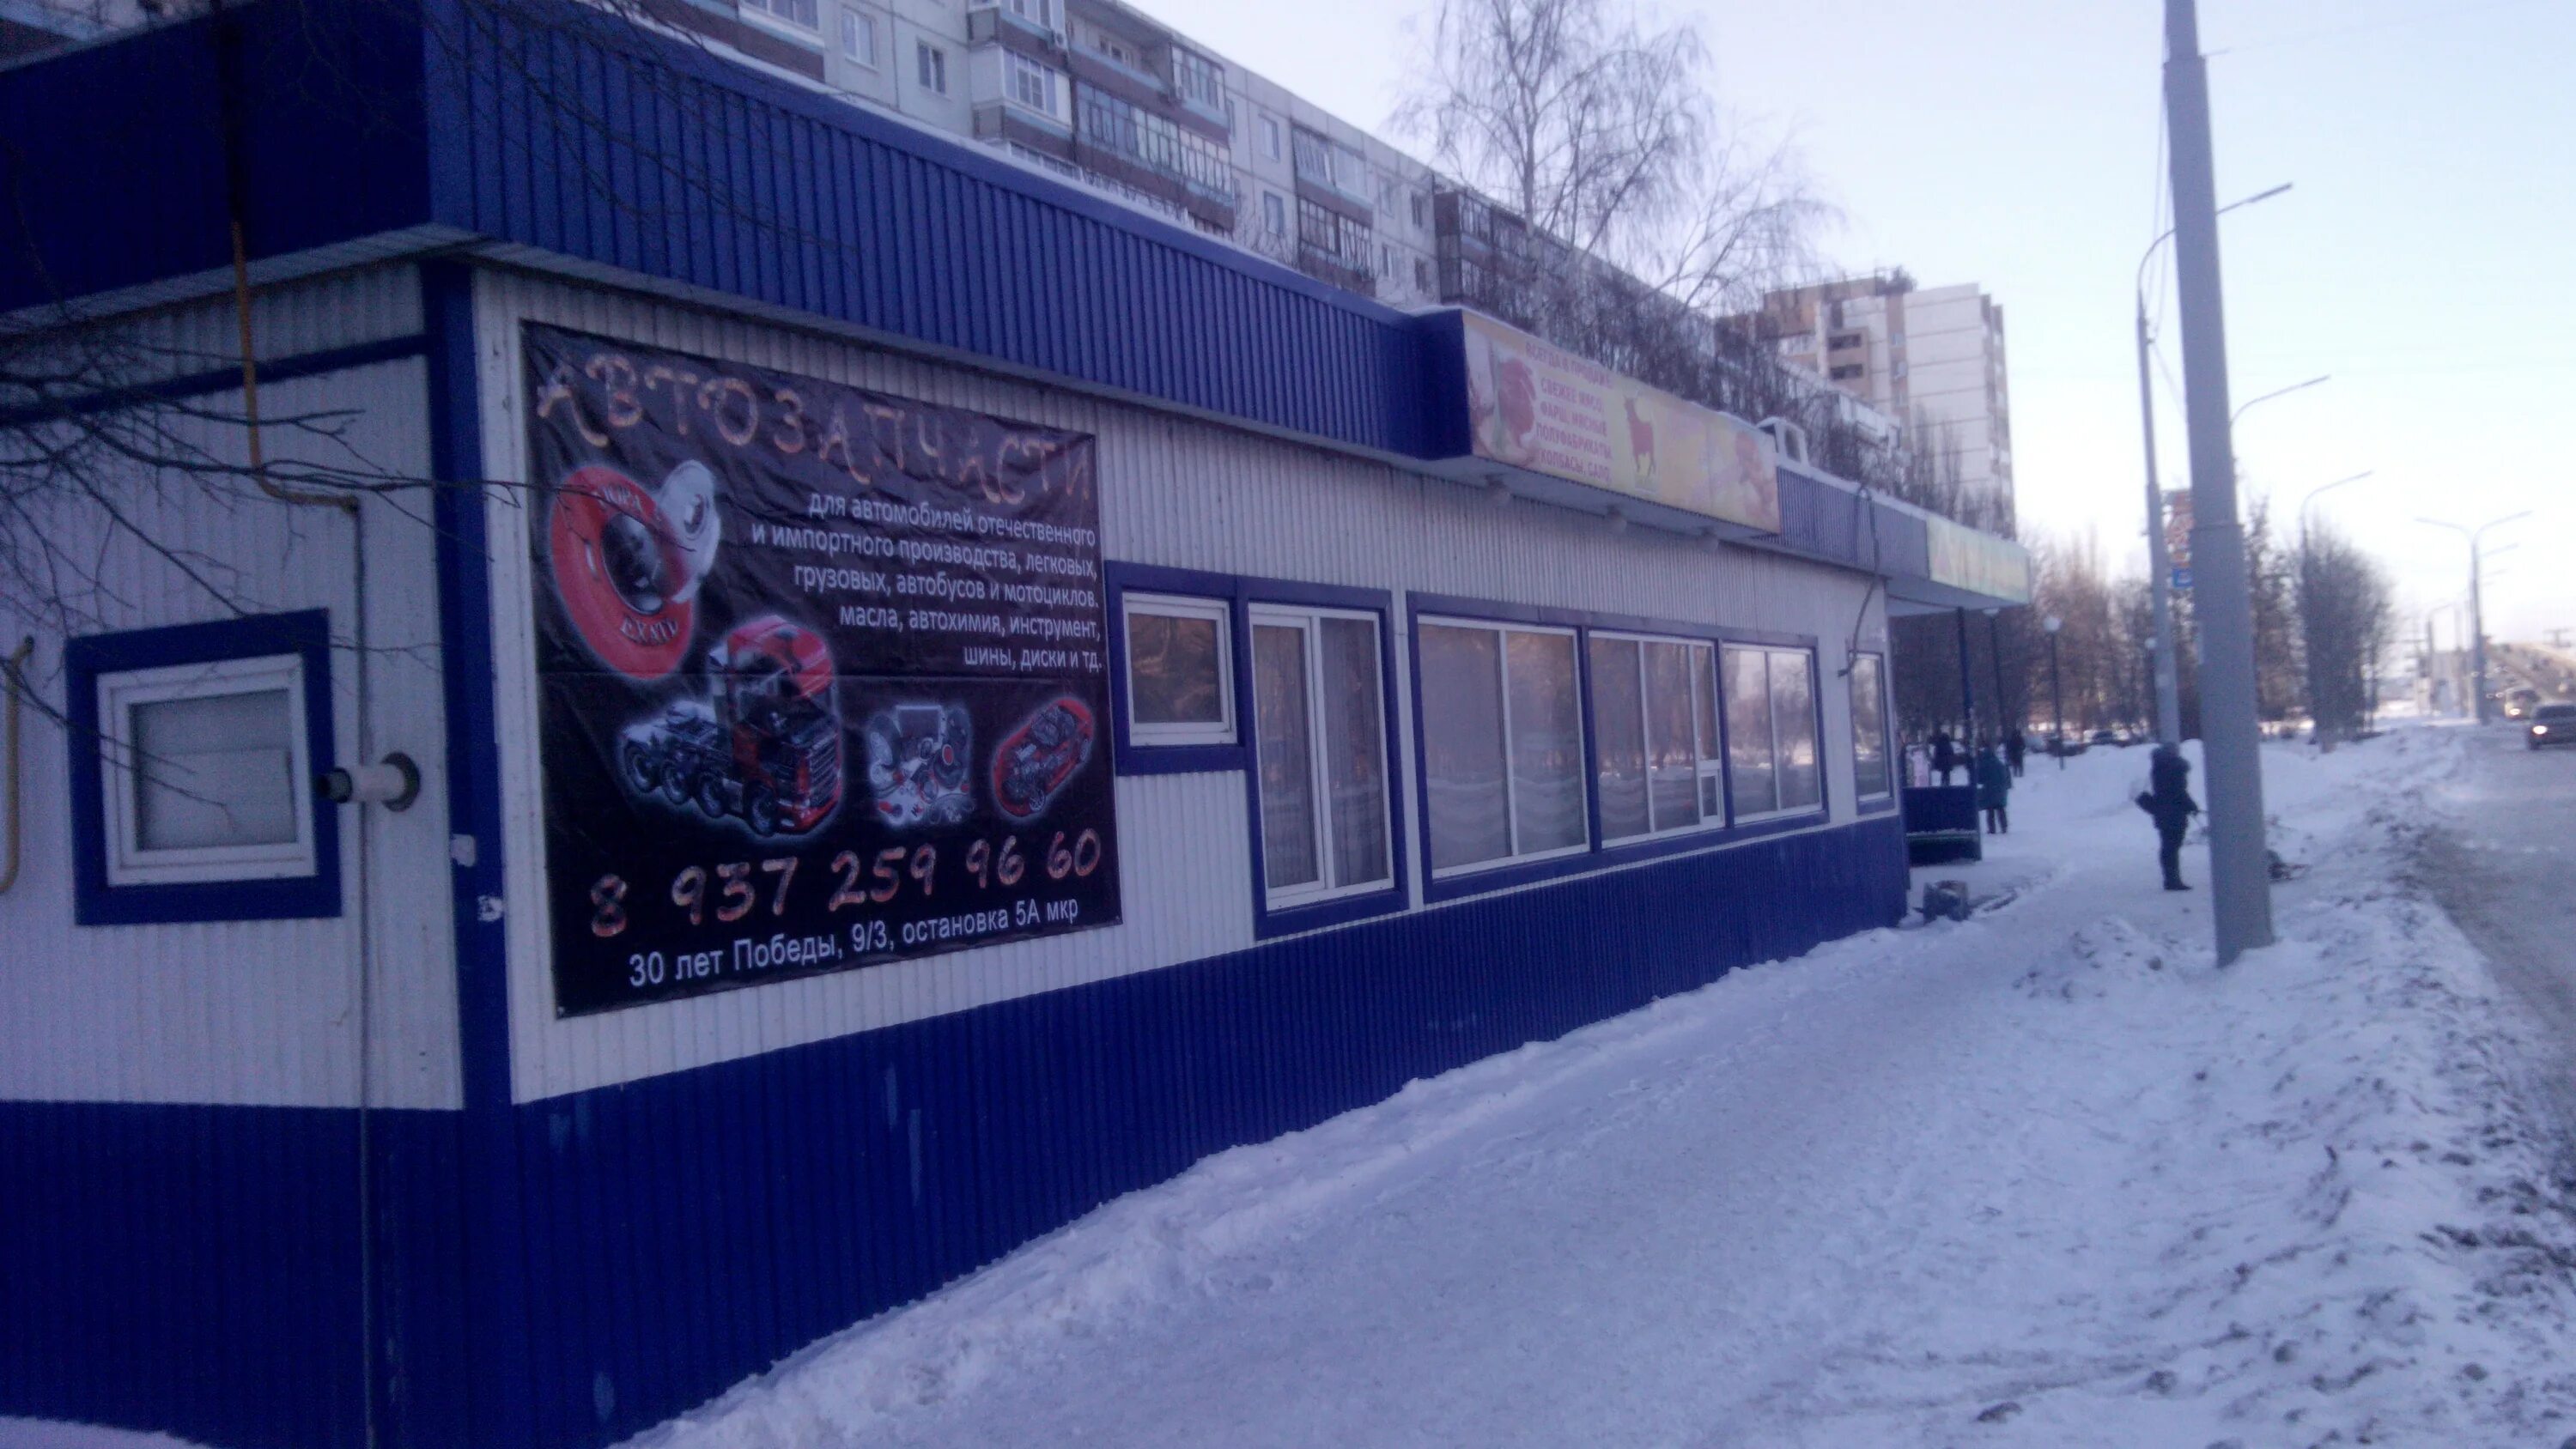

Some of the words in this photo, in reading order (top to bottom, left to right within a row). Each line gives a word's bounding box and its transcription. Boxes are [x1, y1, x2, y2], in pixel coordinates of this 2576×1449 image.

[1540, 377, 1577, 403] СВЕЖЕЕ
[537, 352, 1091, 505] АВТОЗАПЧАСТИ
[809, 493, 846, 519] для
[852, 497, 974, 532] автомобилей
[978, 515, 1097, 547] отечественного
[751, 523, 766, 544] и
[772, 524, 895, 558] импортного
[899, 539, 1022, 575] производства,
[1025, 552, 1098, 582] легковых,
[794, 565, 891, 597] грузовых,
[896, 571, 986, 603] автобусов
[989, 582, 999, 601] и
[1004, 583, 1099, 610] мотоциклов.
[840, 606, 904, 633] масла,
[908, 609, 1005, 637] автохимия,
[1010, 615, 1101, 642] инструмент,
[963, 646, 1017, 670] шины,
[1020, 648, 1066, 673] диски
[1070, 651, 1078, 670] и
[1082, 652, 1103, 673] тд.
[590, 874, 628, 937] 8
[671, 857, 799, 925] 937
[828, 843, 937, 912] 259
[966, 834, 1024, 889] 96
[1047, 828, 1102, 879] 60
[629, 950, 664, 987] 30
[675, 949, 724, 980] лет
[733, 933, 843, 973] Победы,
[851, 919, 894, 953] 9/3,
[903, 908, 1008, 943] остановка
[1016, 898, 1041, 926] 5А
[1047, 898, 1078, 924] мкр
